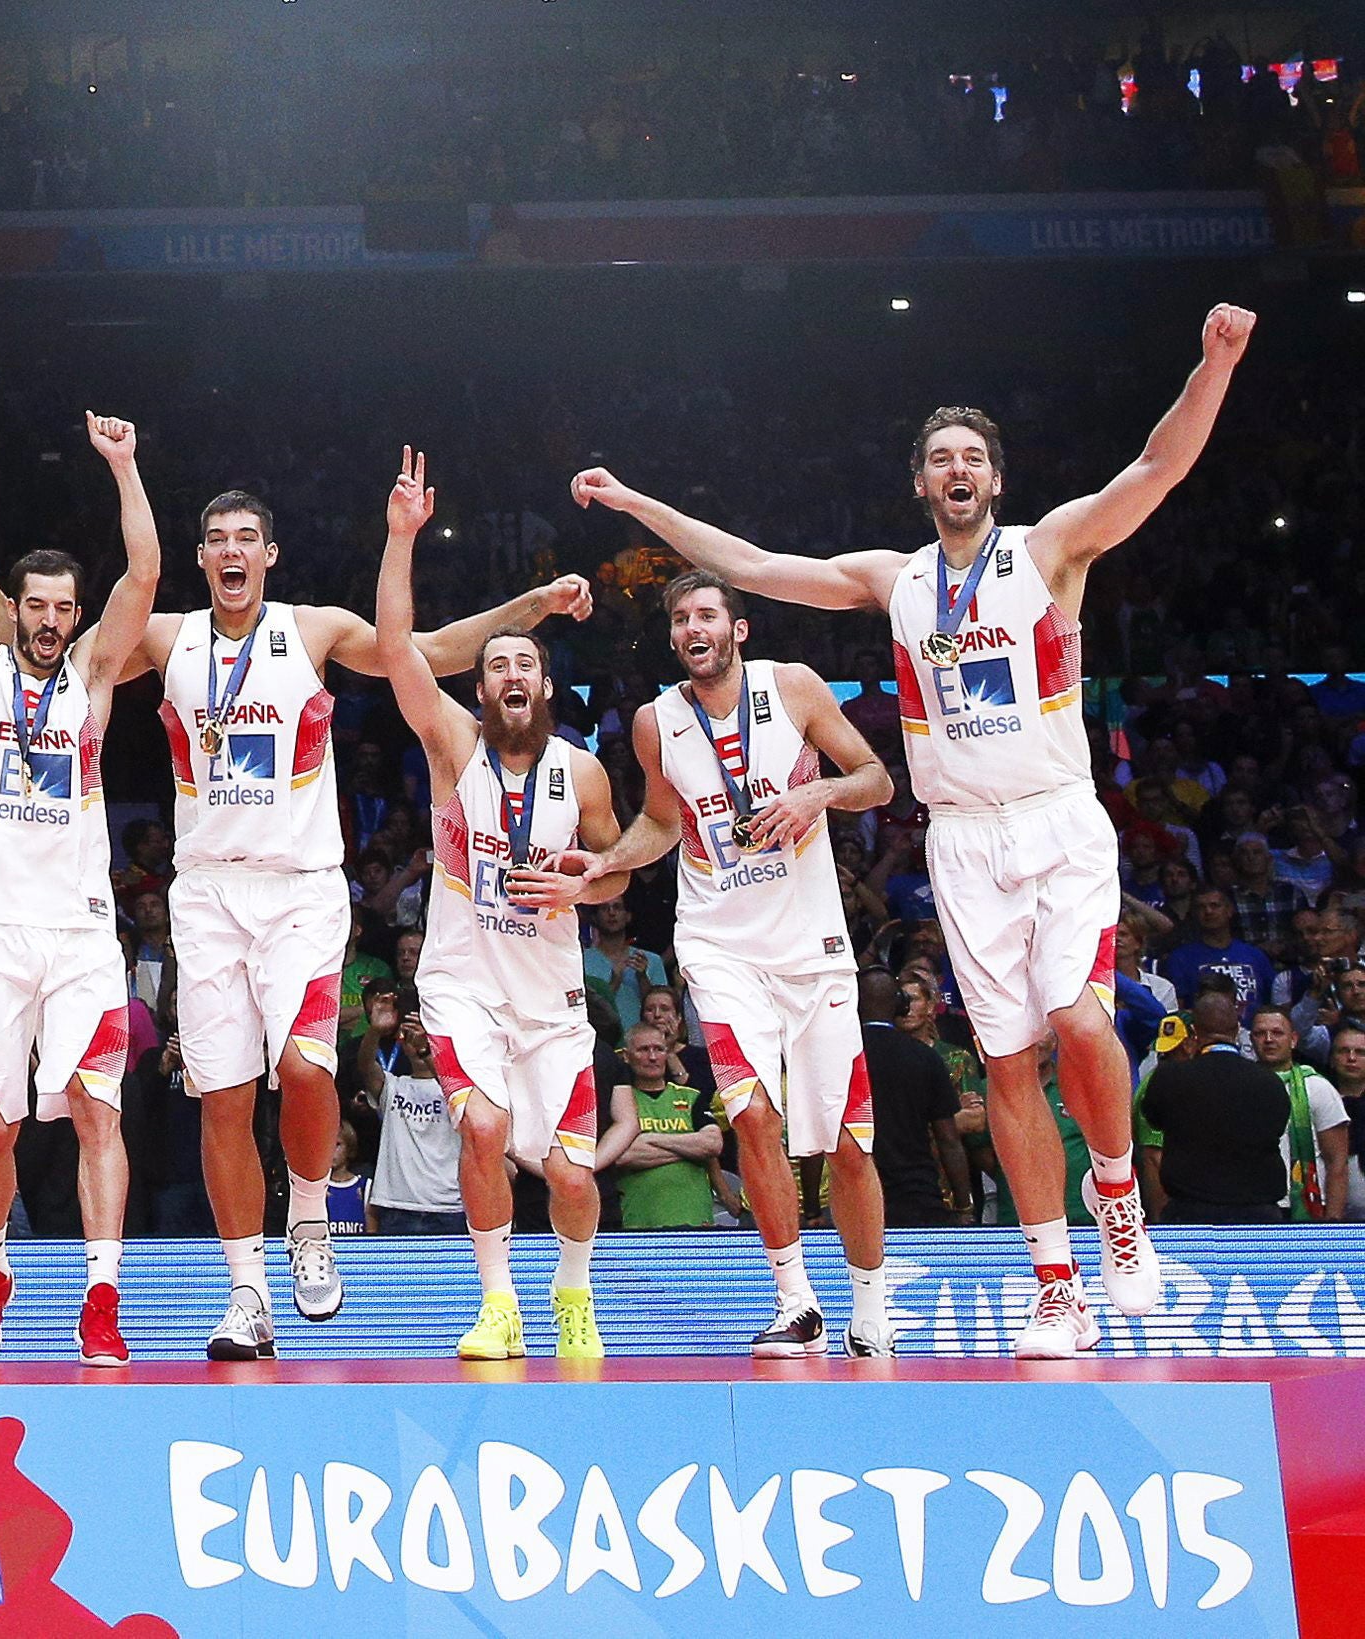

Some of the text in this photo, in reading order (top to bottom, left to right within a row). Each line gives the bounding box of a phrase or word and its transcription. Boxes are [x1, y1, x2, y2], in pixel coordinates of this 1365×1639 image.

[946, 715, 1022, 741] endesa
[208, 784, 274, 806] endesa
[720, 861, 788, 892] endesa
[639, 1117, 689, 1131] IETUVA
[329, 1221, 364, 1234] RANCE
[169, 1440, 1254, 1610] EUROBASKET 2015
